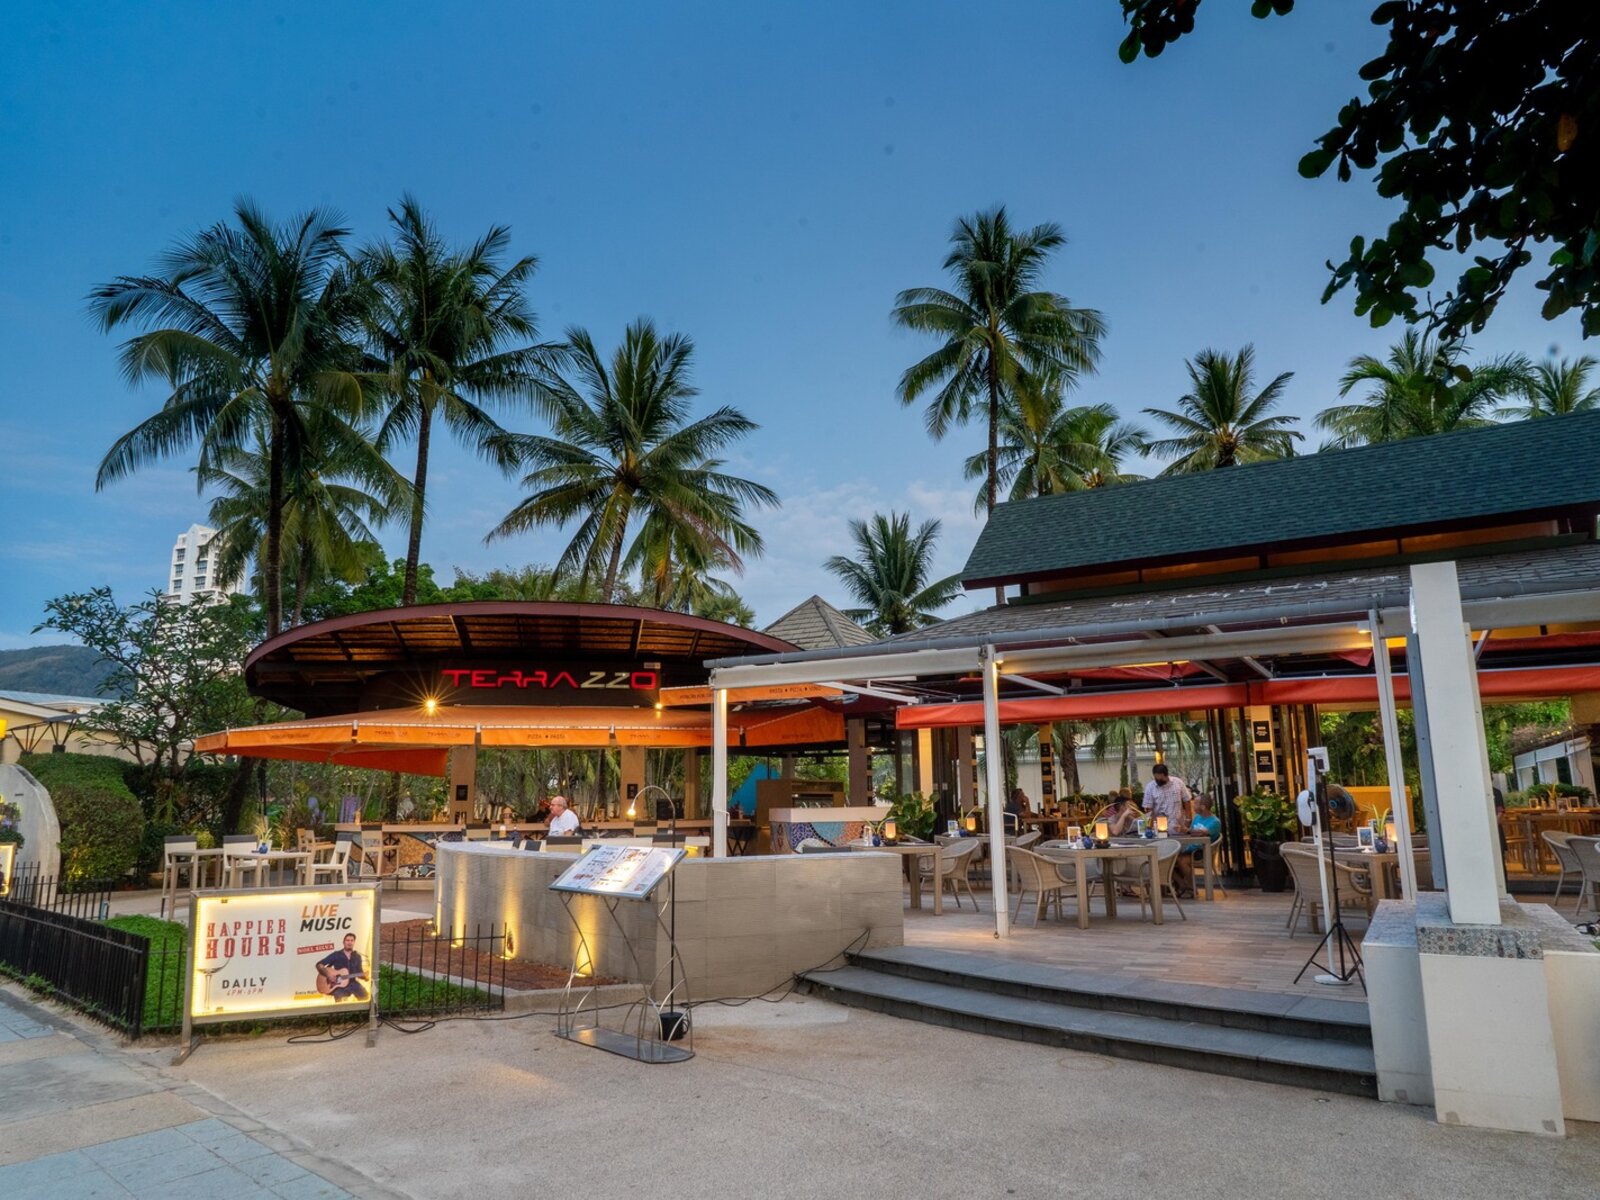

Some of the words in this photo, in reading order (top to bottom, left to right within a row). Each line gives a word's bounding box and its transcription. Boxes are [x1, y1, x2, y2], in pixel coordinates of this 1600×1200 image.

[441, 669, 657, 689] TERRAZZO
[302, 904, 339, 919] LIVE
[206, 918, 286, 938] HAPPIER
[300, 917, 352, 932] MUSIC
[205, 935, 286, 959] HOURS
[222, 977, 267, 989] DAILY
